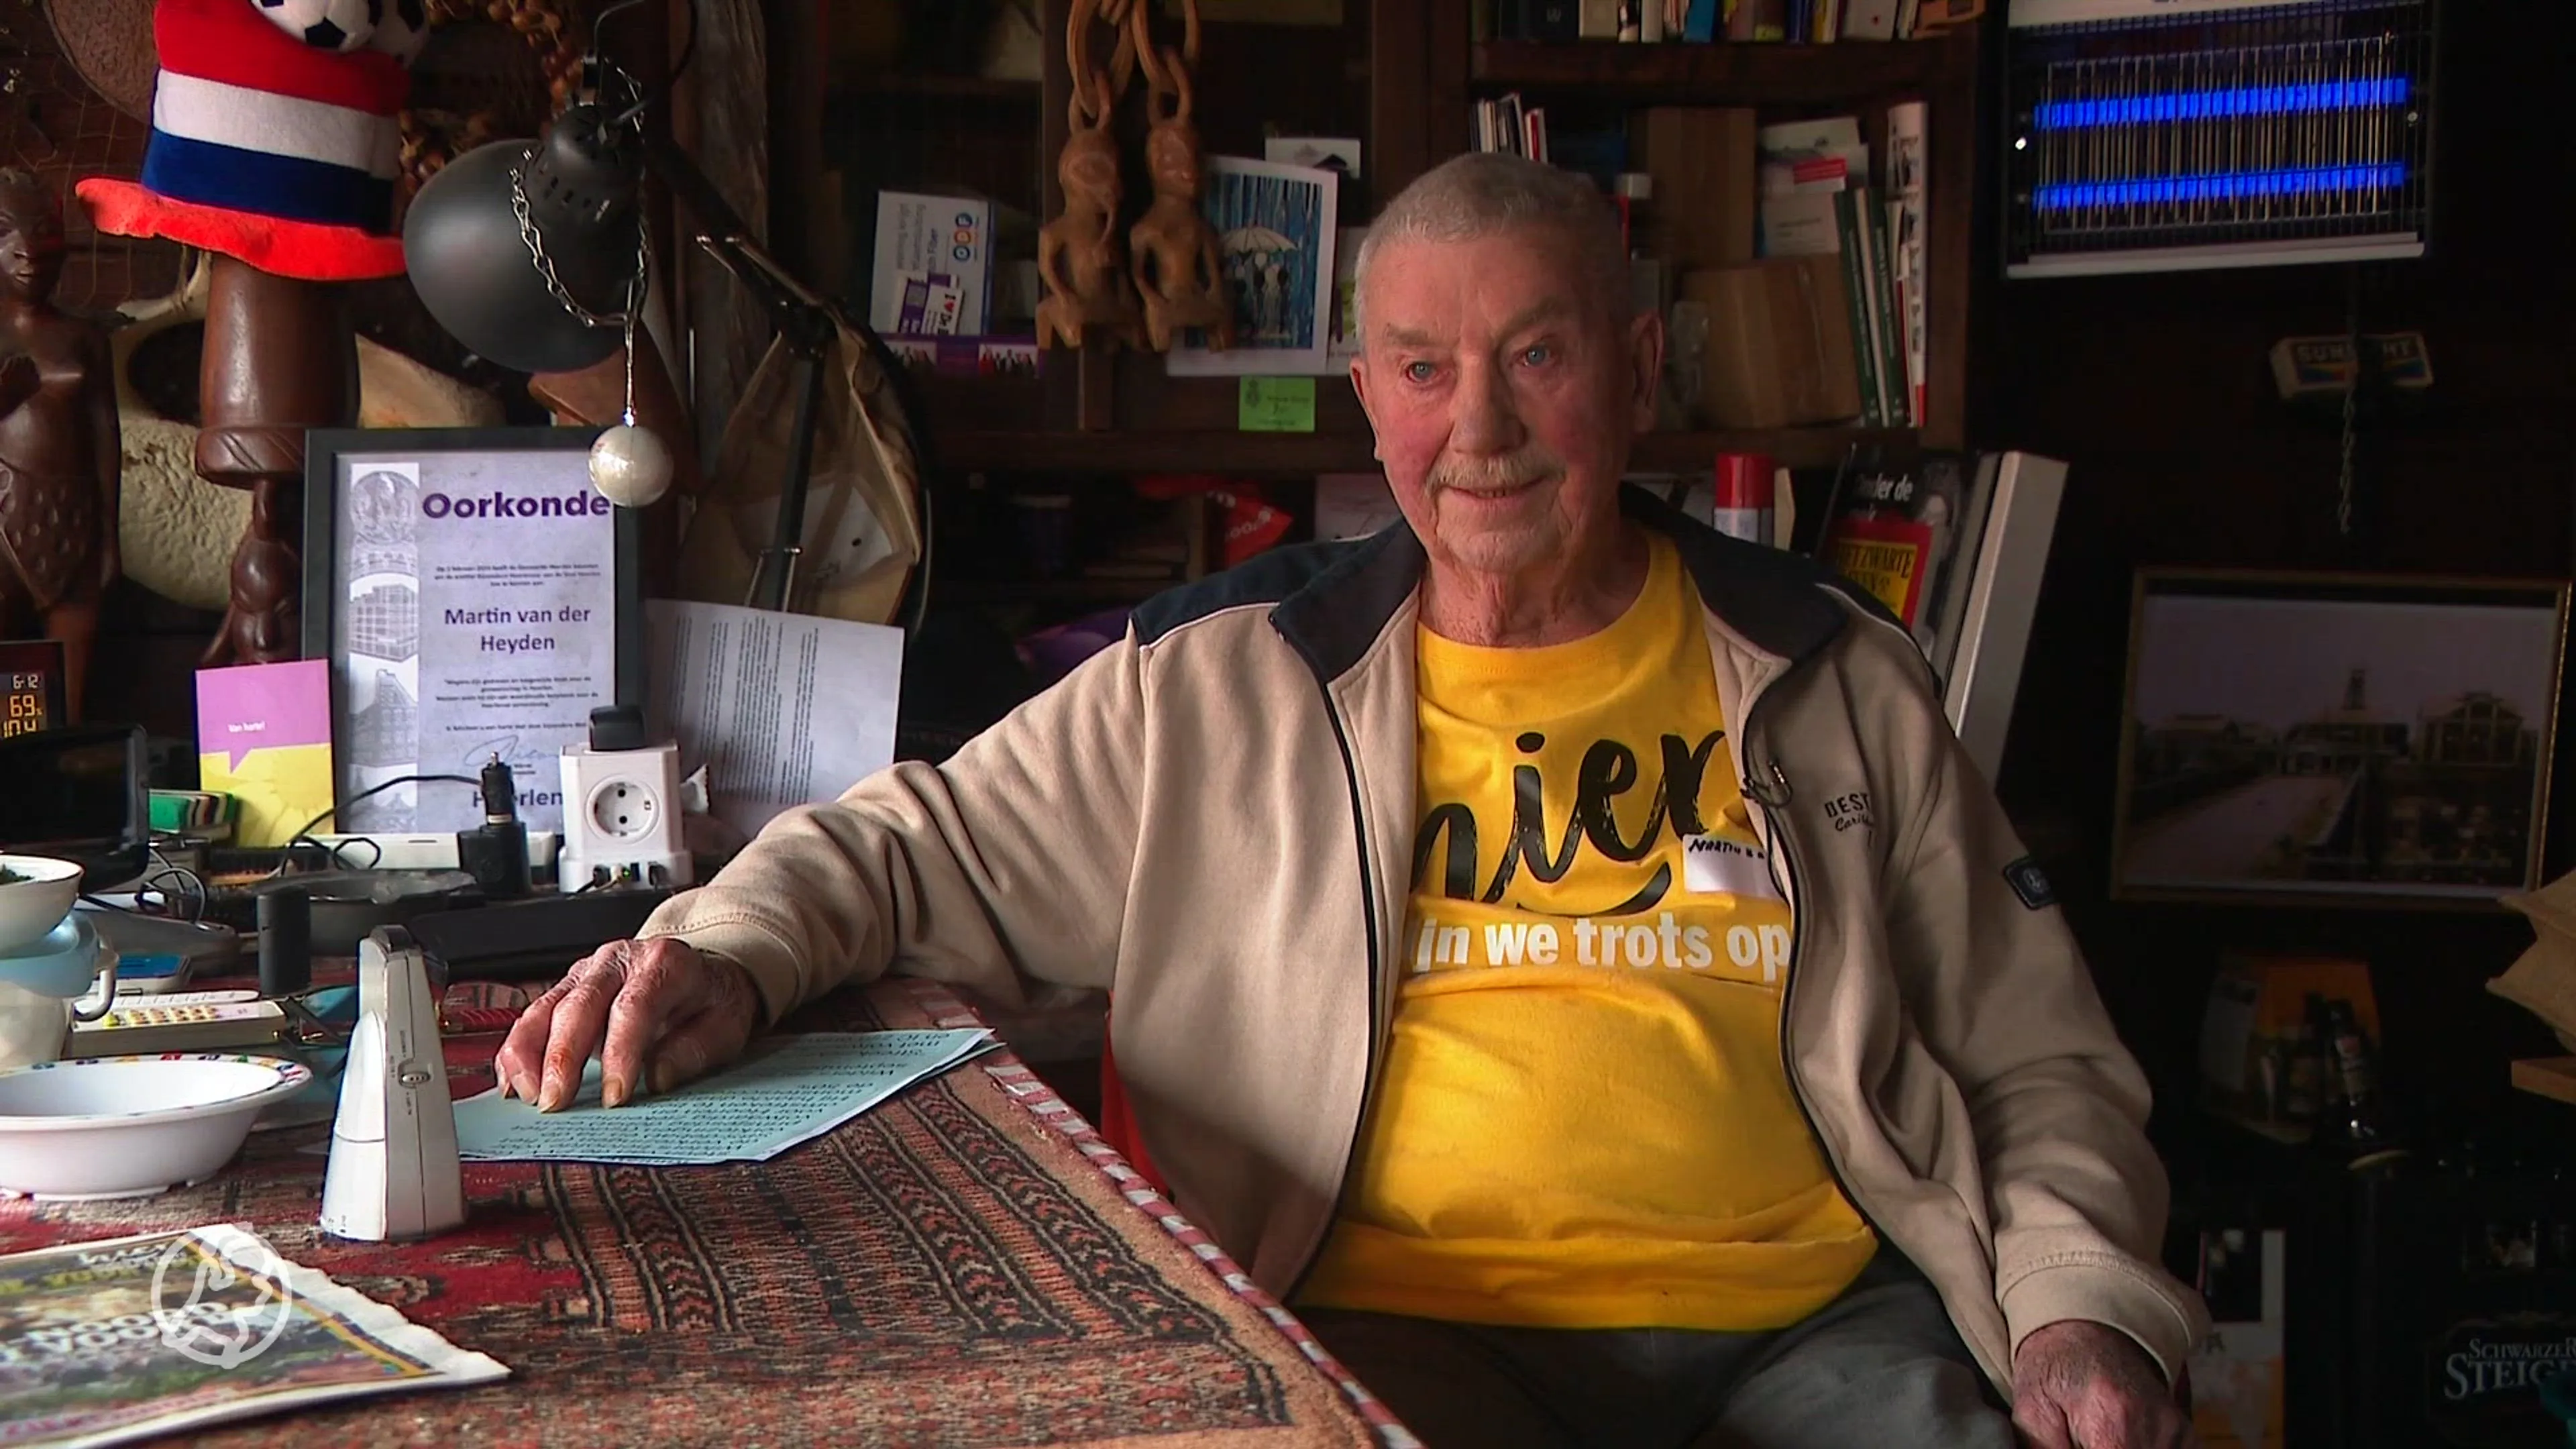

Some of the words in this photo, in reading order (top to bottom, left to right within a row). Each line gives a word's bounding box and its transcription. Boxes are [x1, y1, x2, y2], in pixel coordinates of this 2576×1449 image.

[423, 490, 610, 519] Oorkonde
[444, 607, 511, 625] Martin
[517, 610, 552, 623] van
[559, 606, 591, 622] der
[480, 634, 555, 654] Heyden
[473, 789, 562, 807] Hrlen
[1484, 919, 1559, 967] we
[1572, 912, 1713, 968] trots
[1727, 924, 1792, 981] op
[2443, 1352, 2576, 1400] STEIG
